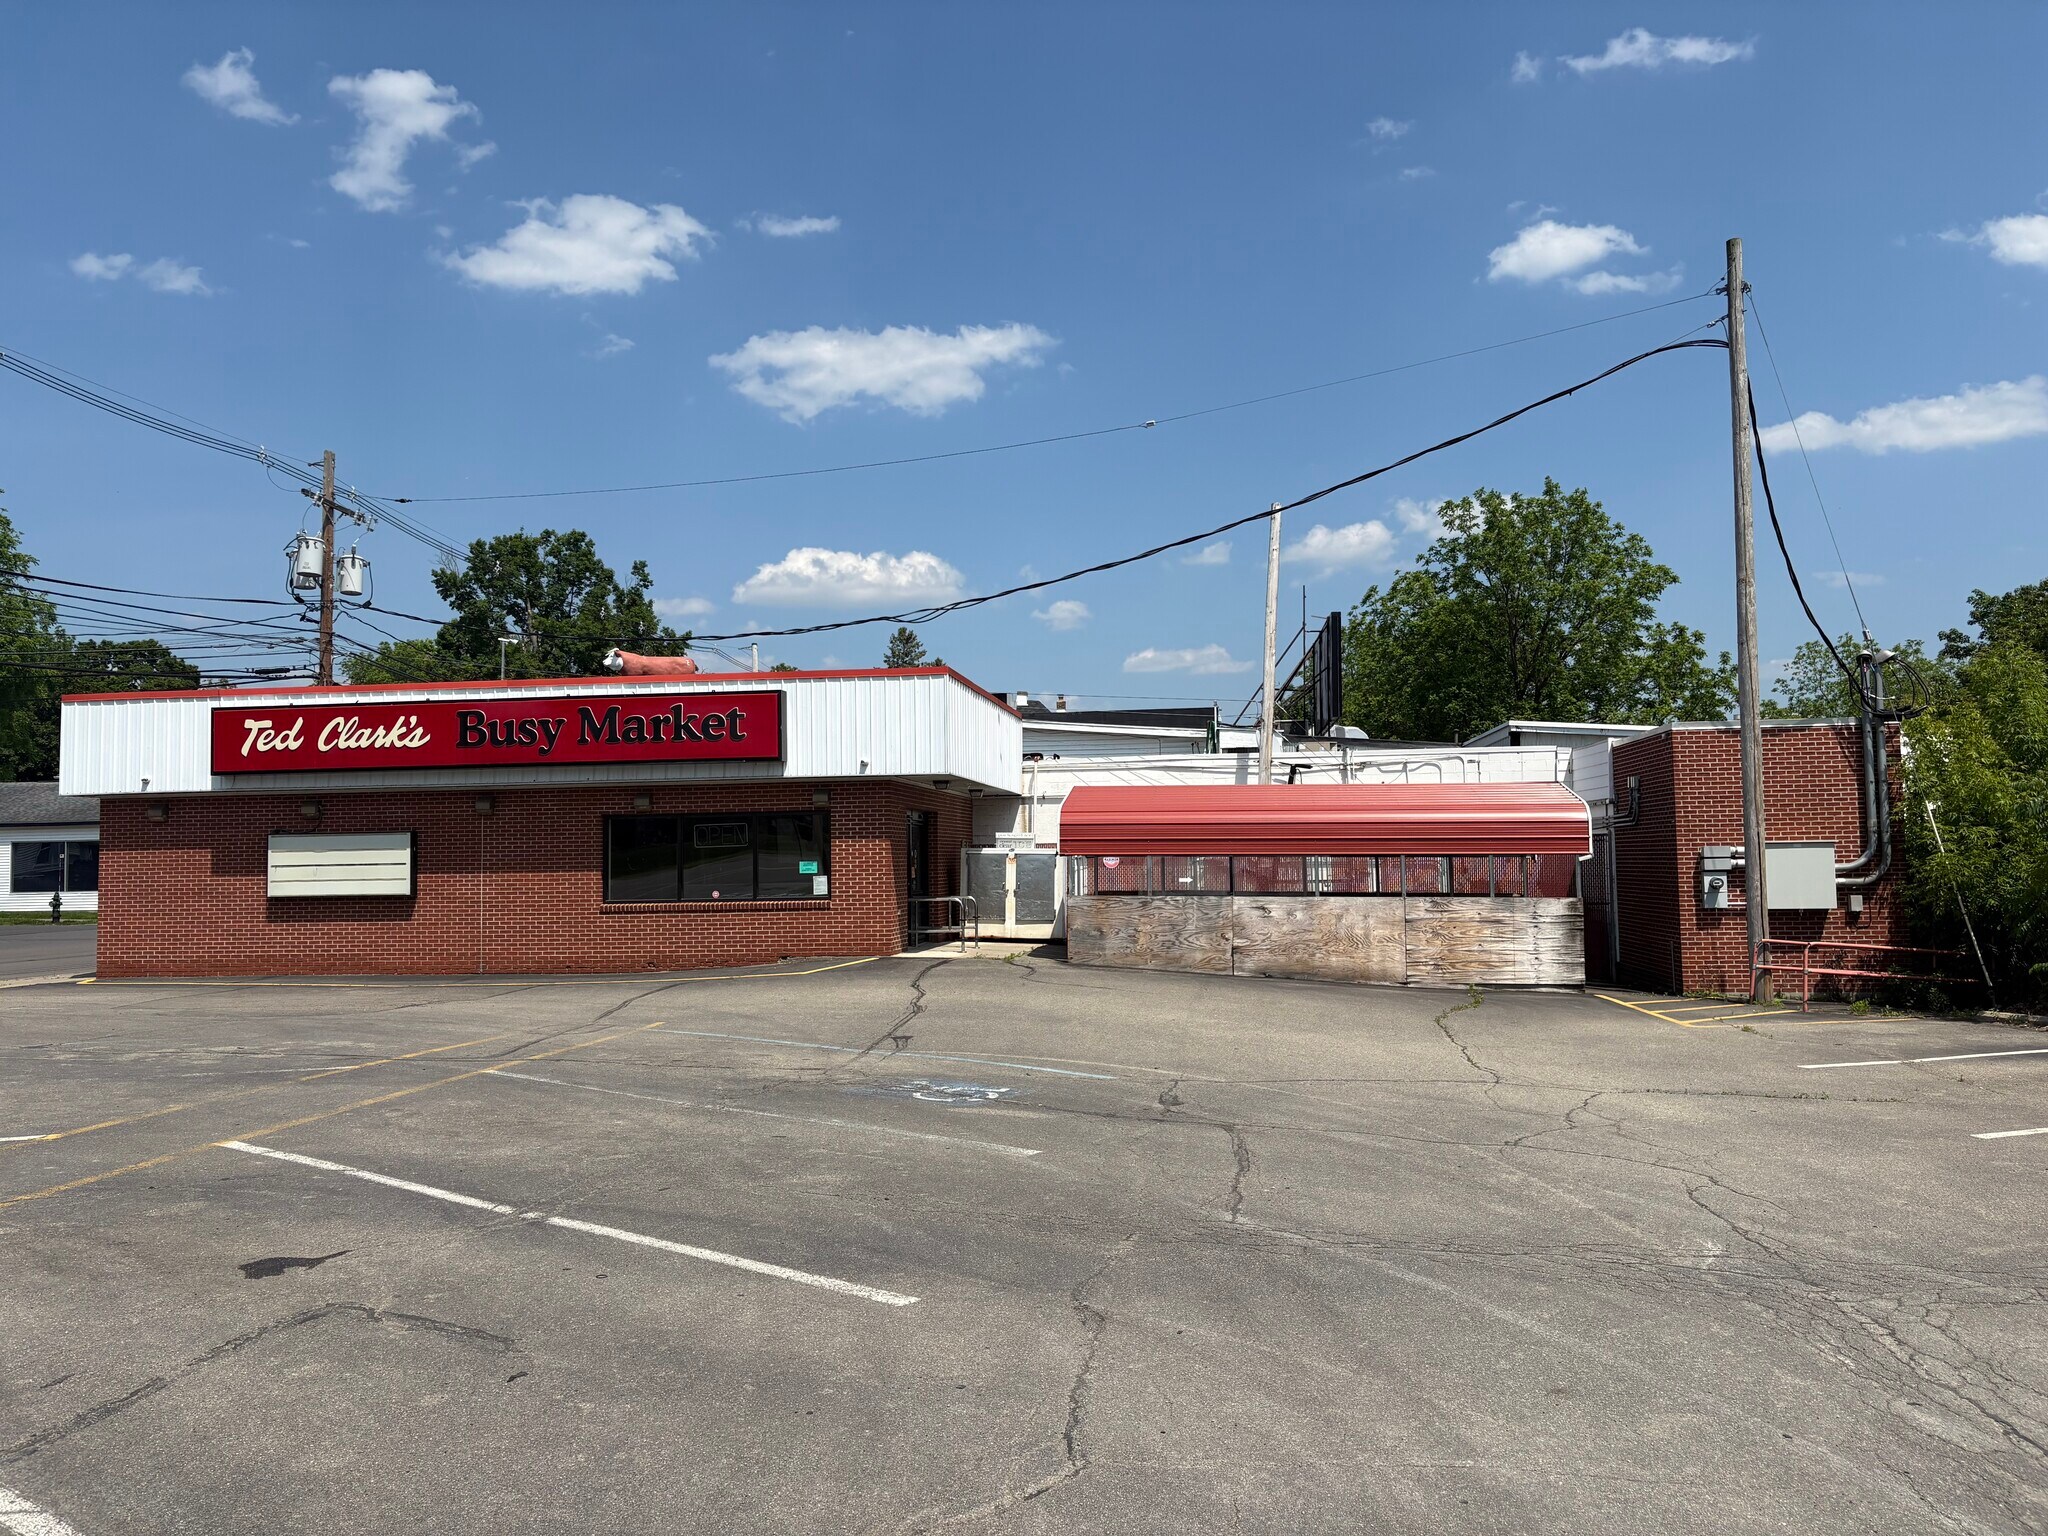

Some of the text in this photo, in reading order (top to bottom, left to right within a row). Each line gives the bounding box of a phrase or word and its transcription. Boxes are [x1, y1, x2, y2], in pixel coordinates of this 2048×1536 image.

[240, 703, 748, 757] Ted Clark's Busy Market
[696, 825, 746, 845] OPEN
